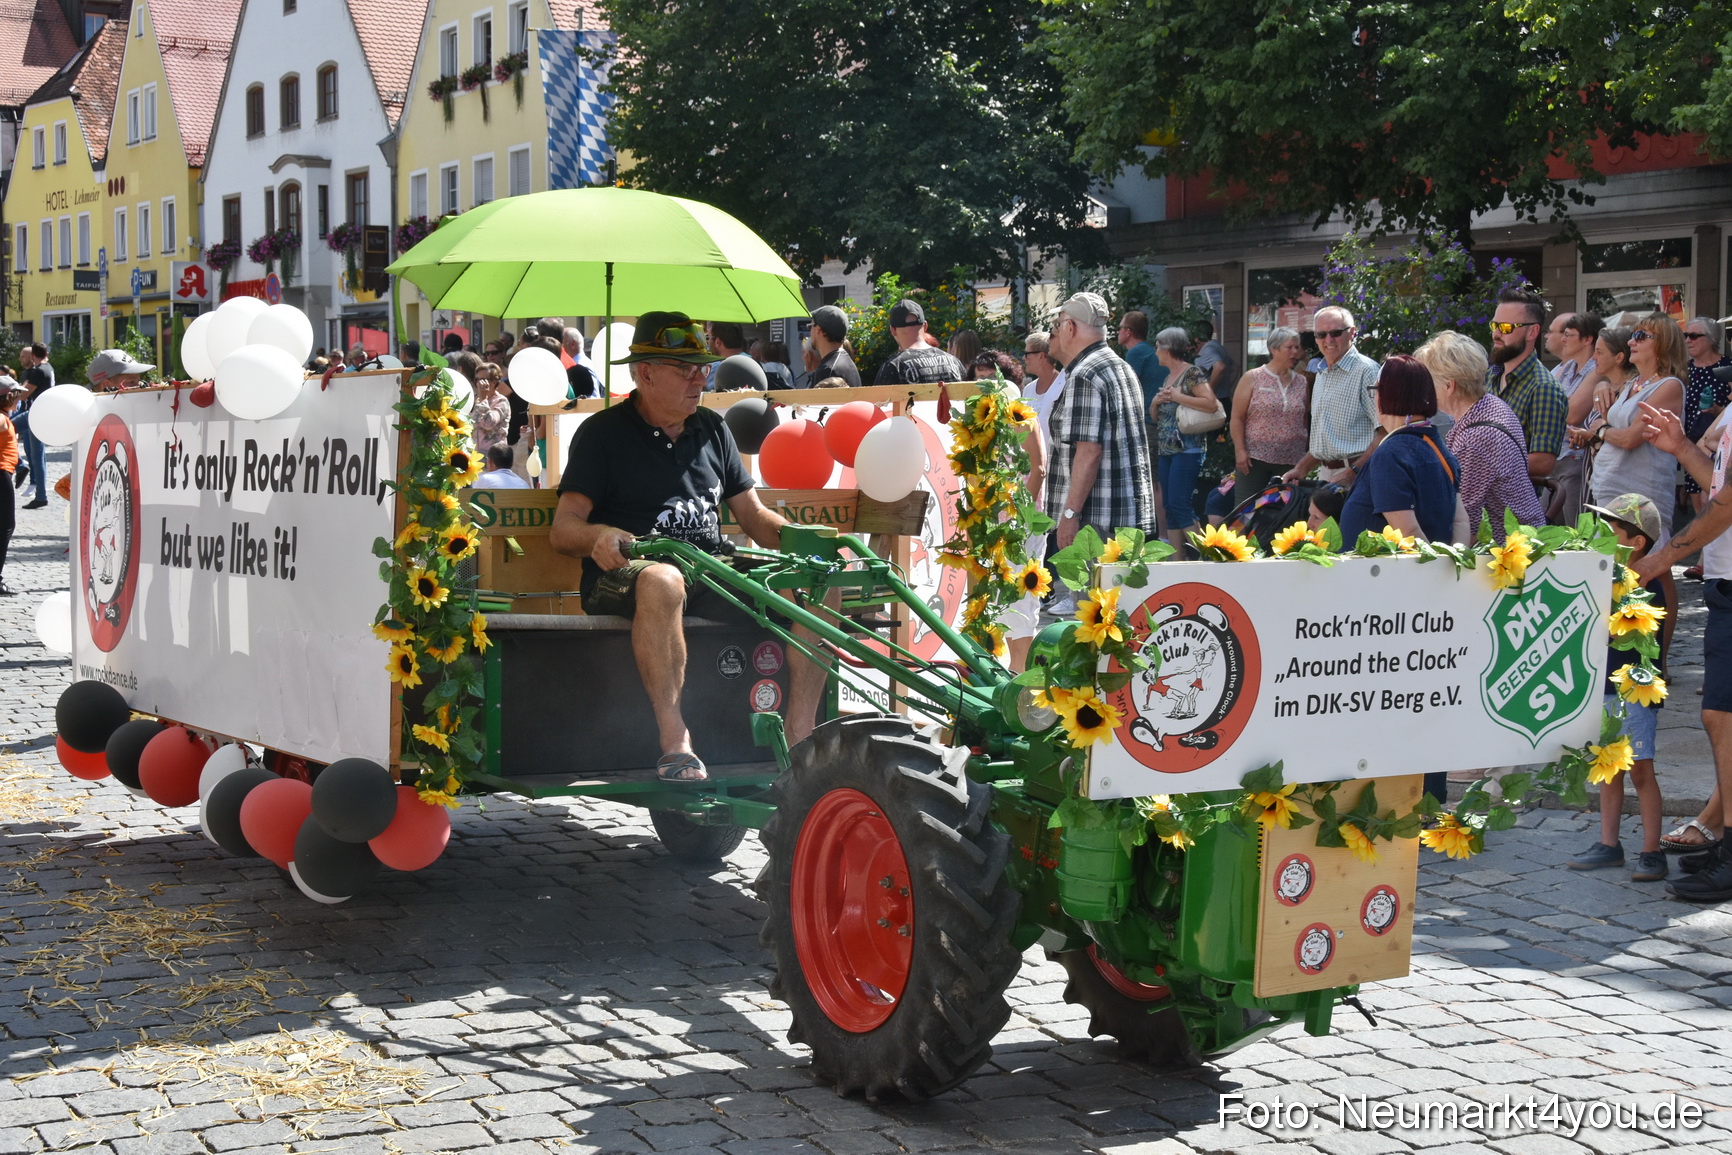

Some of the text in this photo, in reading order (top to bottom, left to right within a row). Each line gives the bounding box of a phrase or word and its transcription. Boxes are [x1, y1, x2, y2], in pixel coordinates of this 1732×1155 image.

[46, 190, 68, 212] HOTEL
[134, 272, 138, 293] P
[46, 292, 77, 306] Restaurant
[195, 439, 238, 502] only
[161, 516, 298, 581] but we like it!
[1412, 610, 1454, 634] Club
[1503, 589, 1552, 651] DJK
[1162, 642, 1190, 663] Club
[1368, 651, 1400, 673] the
[1496, 650, 1542, 700] BERG
[1551, 606, 1585, 644] OPF.
[1230, 674, 1238, 688] the
[1528, 654, 1575, 721] SV
[1274, 685, 1462, 718] im DJK-SV Berg e.V.
